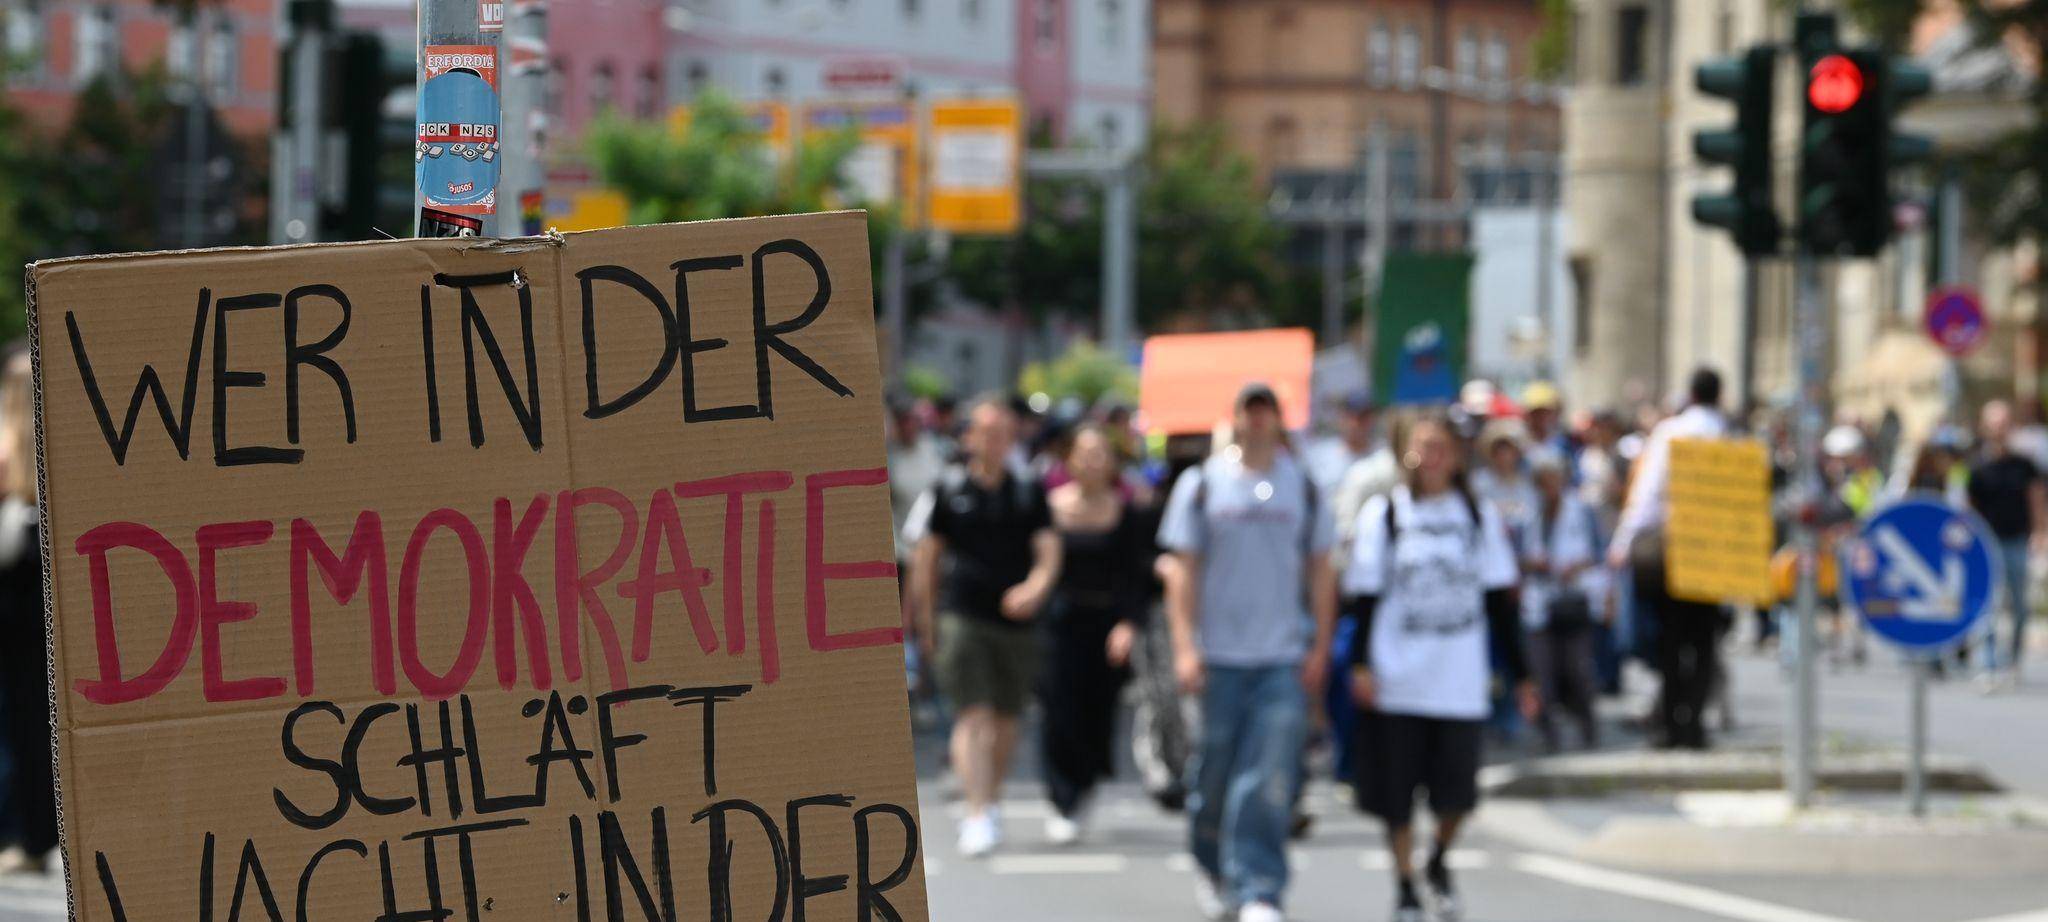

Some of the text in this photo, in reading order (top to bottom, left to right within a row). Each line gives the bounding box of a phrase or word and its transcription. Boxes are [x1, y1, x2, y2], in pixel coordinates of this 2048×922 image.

[427, 54, 494, 68] ERFORDIA
[420, 124, 494, 136] FCK NZS
[453, 183, 472, 194] JUSOS
[65, 238, 856, 466] WER IN DER
[74, 468, 904, 706] DEMOKRATIE
[272, 684, 753, 830] SCHLÄFT
[570, 813, 677, 922] IN
[691, 796, 921, 922] DER
